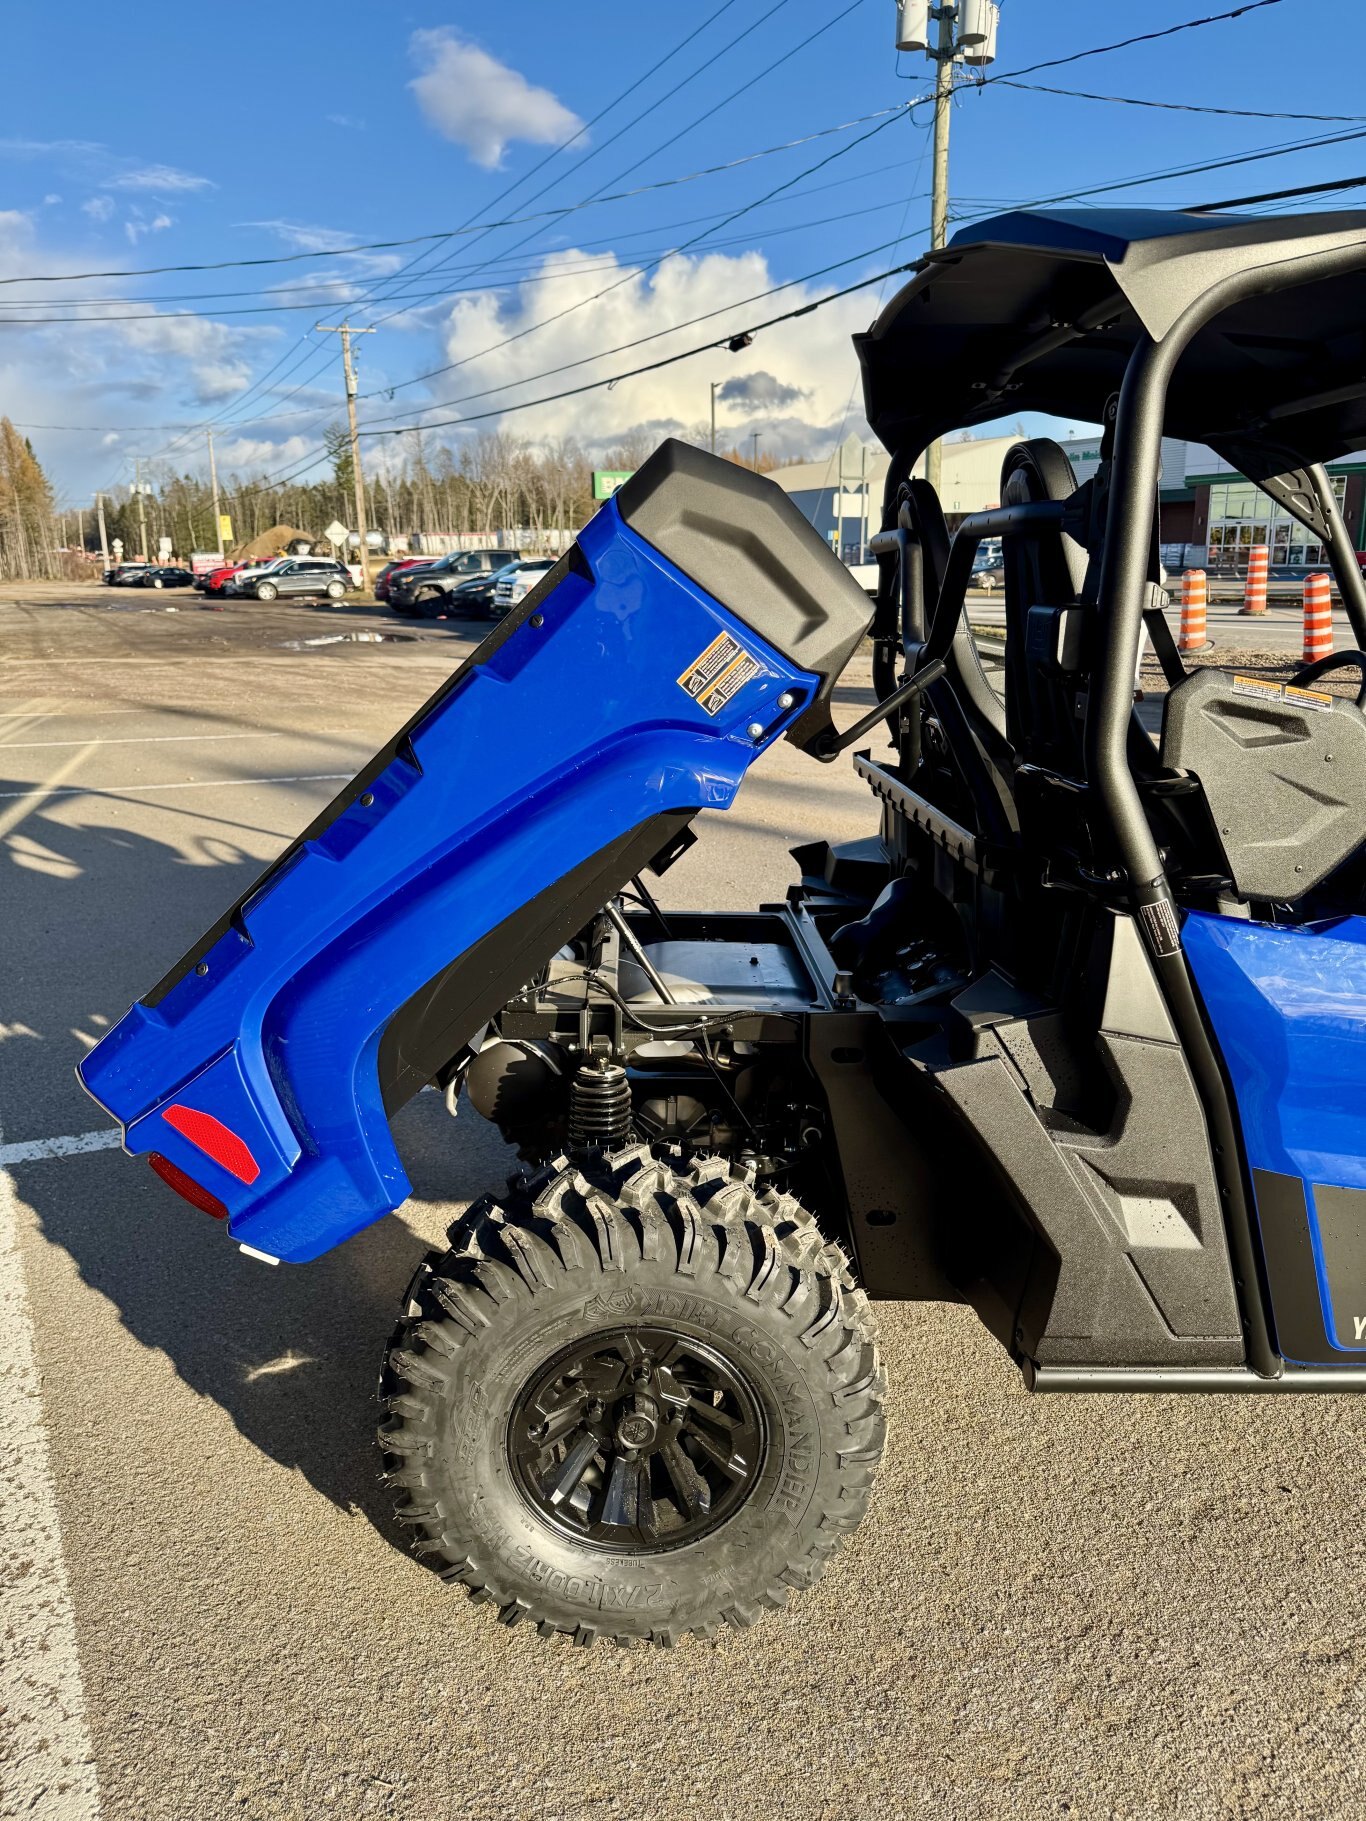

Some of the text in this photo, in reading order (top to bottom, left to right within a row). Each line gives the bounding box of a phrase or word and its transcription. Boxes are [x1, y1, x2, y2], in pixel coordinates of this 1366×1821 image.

[1353, 1316, 1366, 1340] Y
[655, 1294, 816, 1515] DIRT COMMANDER
